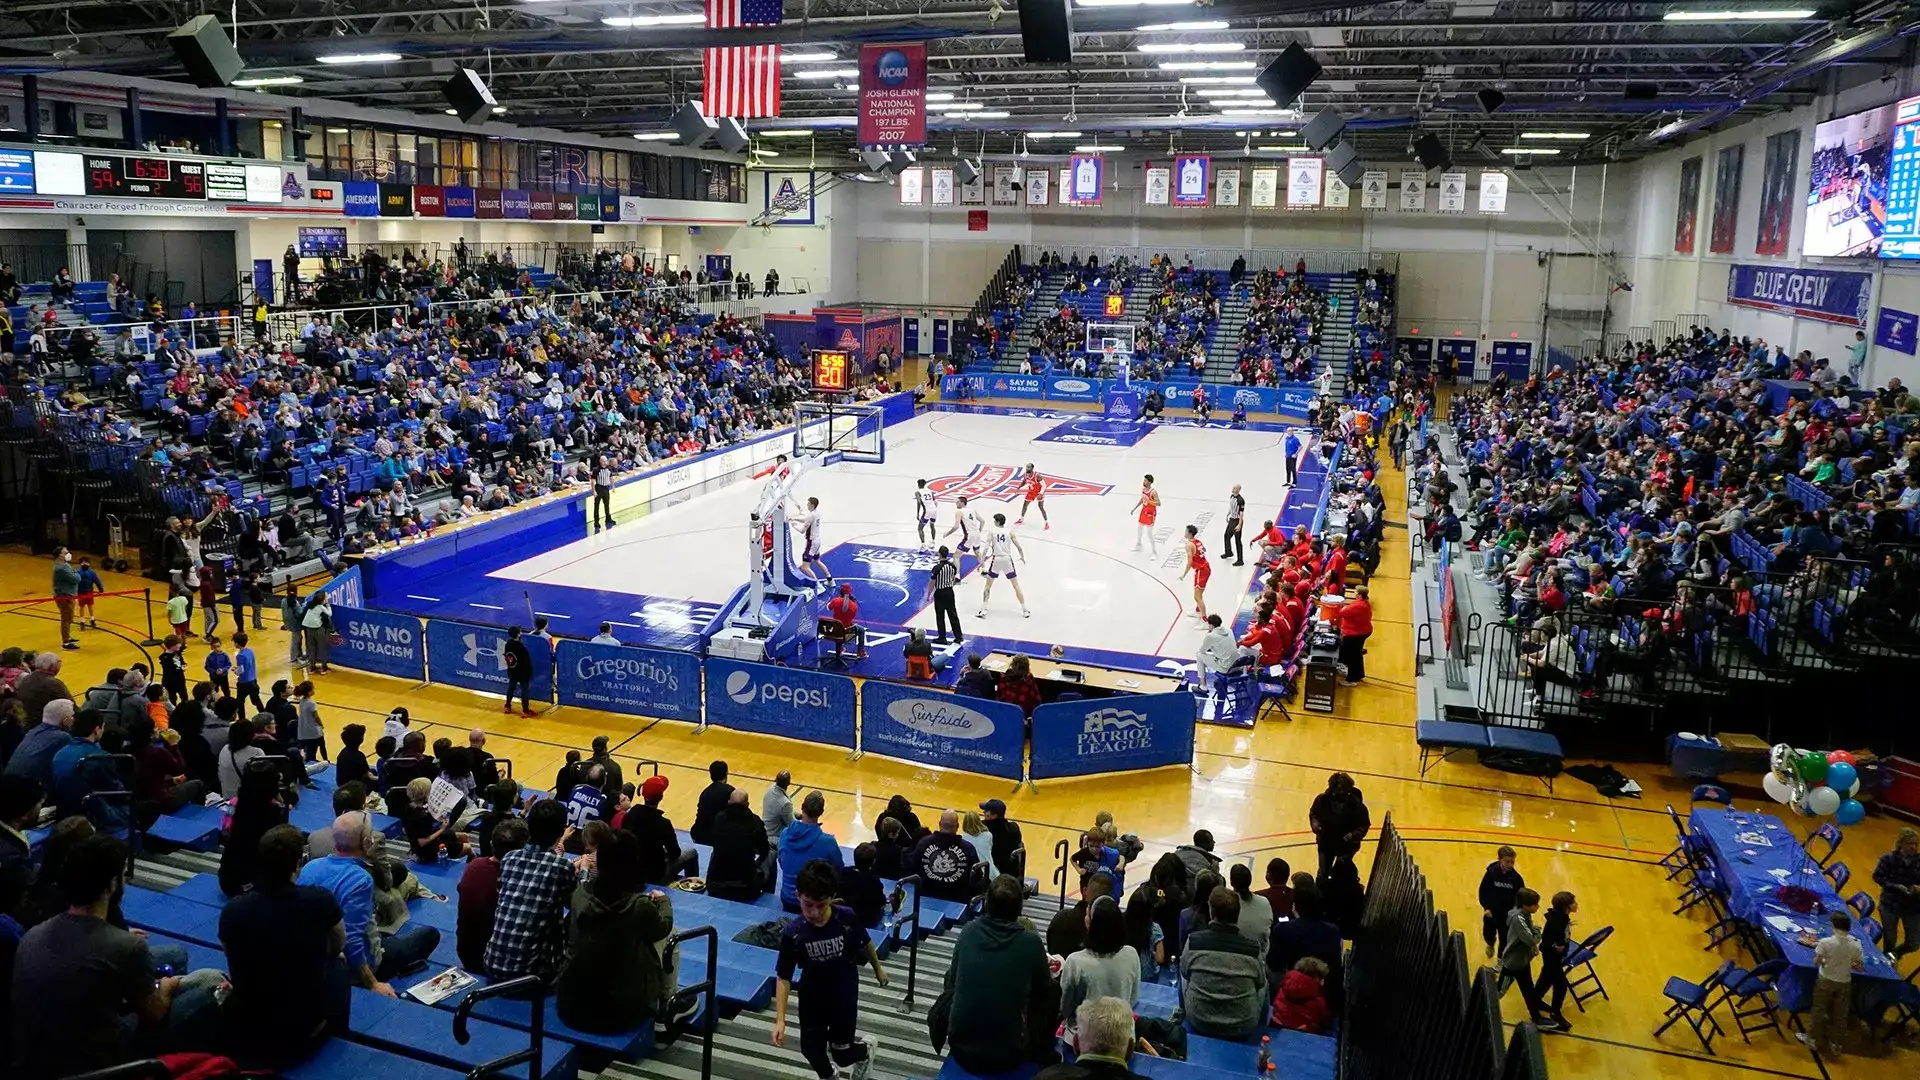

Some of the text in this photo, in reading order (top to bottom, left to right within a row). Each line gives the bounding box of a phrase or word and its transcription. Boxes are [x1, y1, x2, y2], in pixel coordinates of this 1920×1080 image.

[879, 67, 908, 77] NCAA
[869, 108, 916, 116] CHAMPION
[879, 131, 905, 140] 2007
[90, 160, 112, 169] HOME
[135, 160, 168, 178] 6:56
[180, 164, 202, 174] GUEST
[92, 170, 113, 189] 59
[184, 176, 202, 192] 56
[1186, 176, 1198, 184] 24
[154, 182, 161, 195] 2
[345, 194, 377, 204] AMERICAN
[388, 196, 404, 205] ARMY
[420, 196, 439, 206] BOSTON
[480, 200, 500, 209] COLGATE
[515, 200, 530, 209] CROSS
[558, 202, 573, 210] LEHIGH
[56, 201, 225, 213] Character Forged Through Competition
[581, 202, 596, 211] LOYOLA
[1754, 272, 1830, 307] BLUE CREW
[822, 354, 844, 367] 6:56
[819, 366, 840, 386] 20
[666, 467, 690, 488] AMERICAN
[996, 534, 1005, 542] 14
[327, 576, 360, 608] RICAN
[350, 622, 412, 644] SAY NO
[350, 639, 412, 660] TO RACISM
[456, 670, 510, 684] UNDER ARMO
[576, 656, 679, 692] Gregorio's
[602, 680, 650, 694] TRATTORIA
[575, 692, 680, 712] BETHESDA POTOMAC RESTON
[762, 682, 828, 708] pepsi
[908, 702, 972, 730] Surfside
[1078, 726, 1153, 742] PATRIOT
[1078, 738, 1152, 756] LEAGUE
[574, 792, 600, 806] BARKLEY
[566, 800, 600, 830] 26
[805, 935, 844, 958] RAVENS
